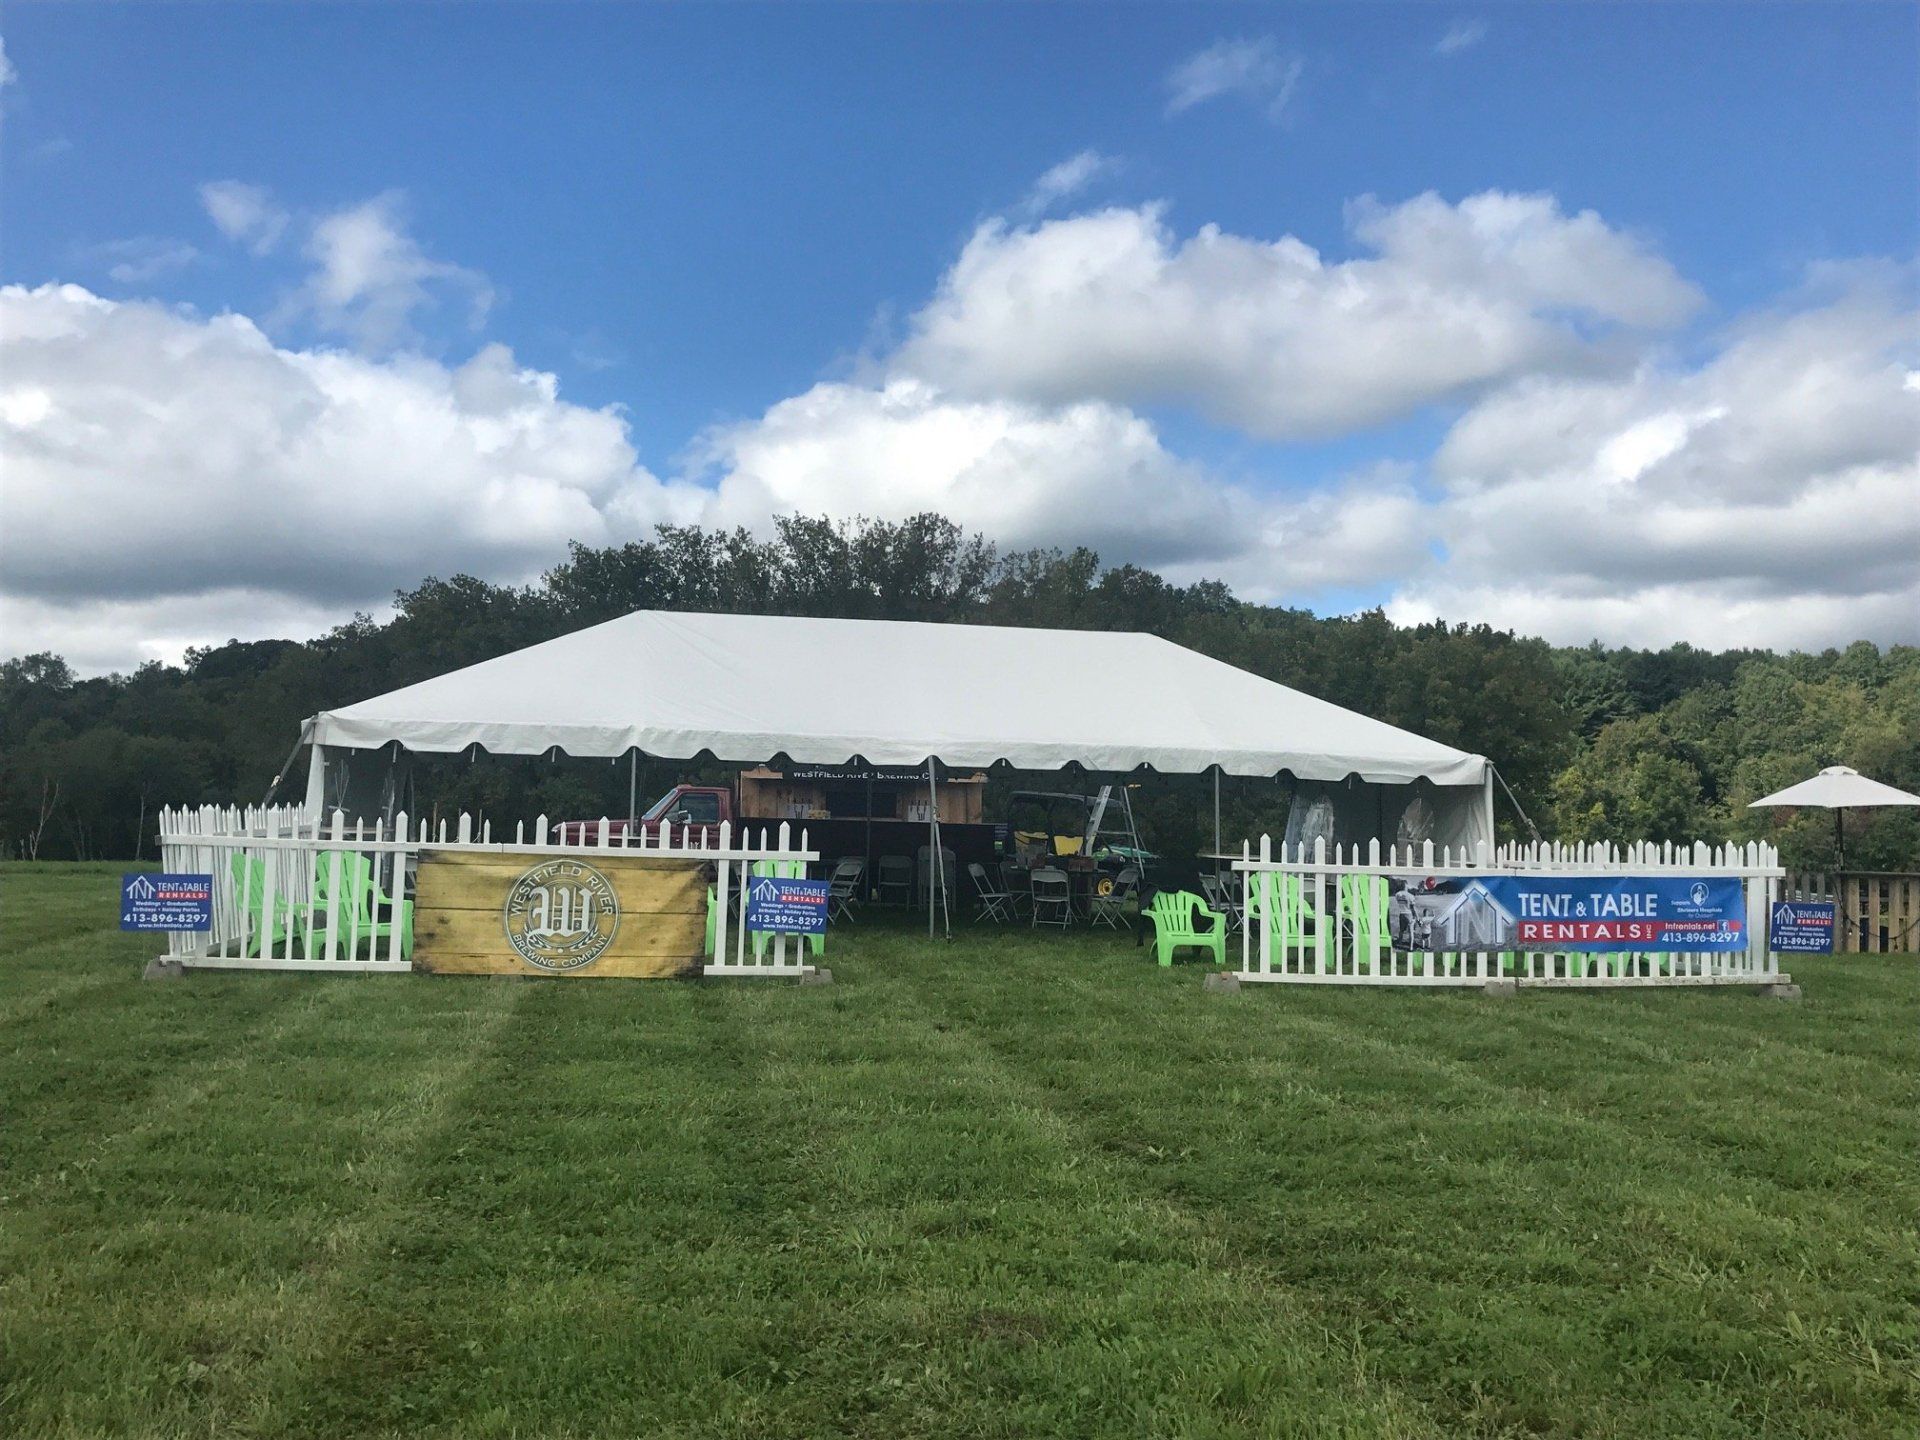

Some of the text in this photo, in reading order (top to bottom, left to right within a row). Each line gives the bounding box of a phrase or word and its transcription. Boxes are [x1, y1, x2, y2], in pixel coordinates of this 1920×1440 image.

[510, 865, 613, 917] WESTFIELD RIVER
[1518, 893, 1659, 917] TENT & TABLE
[123, 913, 208, 923] 413-896-8297
[749, 914, 824, 926] 413-896-8297
[1523, 924, 1641, 939] RENTALS
[1661, 932, 1740, 943] 413-896-8297
[1771, 936, 1831, 946] 413-896-8297
[513, 933, 608, 968] BREWING COMPANY
